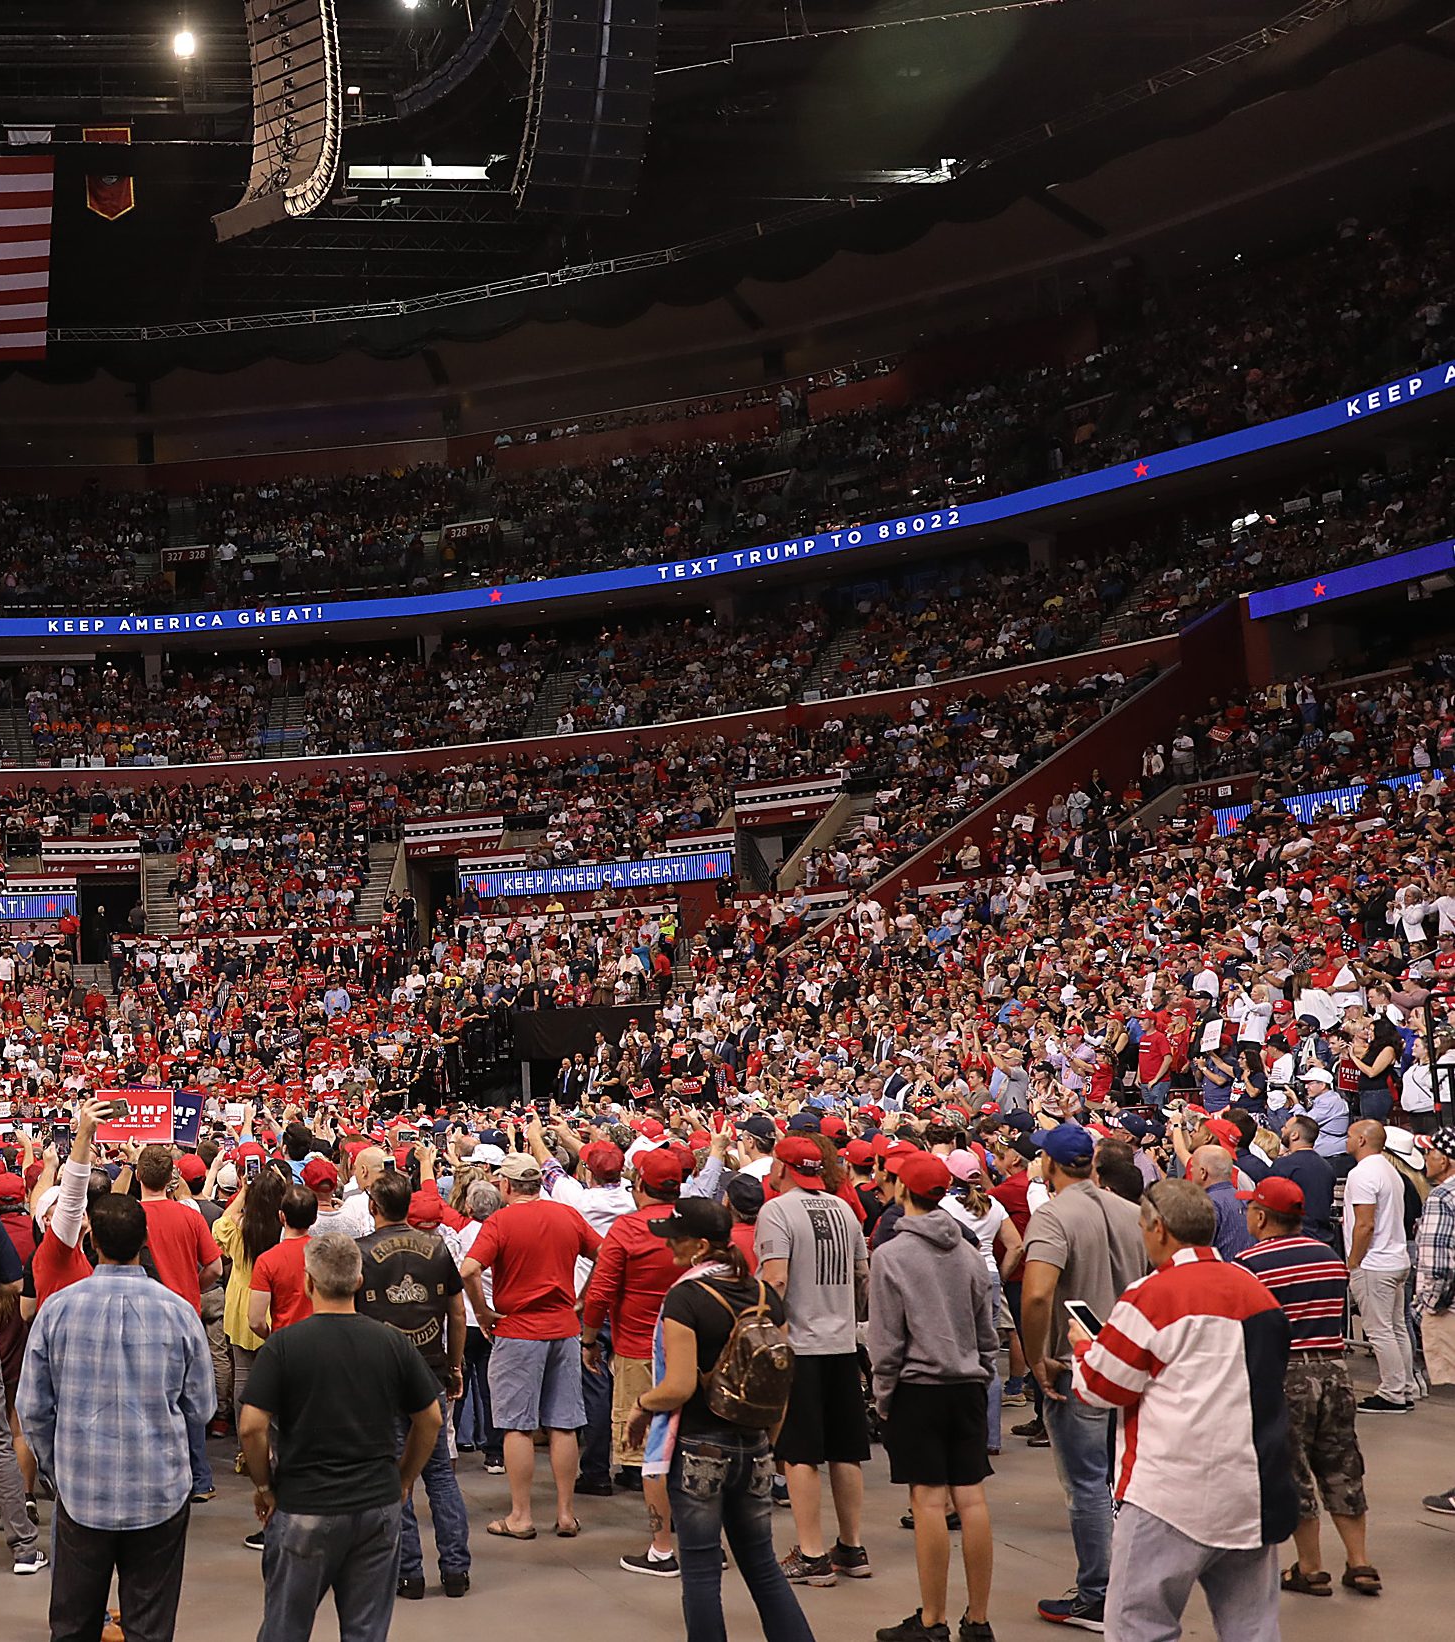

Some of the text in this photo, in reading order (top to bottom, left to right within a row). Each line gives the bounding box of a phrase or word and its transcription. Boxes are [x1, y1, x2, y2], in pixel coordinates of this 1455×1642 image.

[1346, 378, 1422, 417] KEEP
[167, 549, 206, 562] 327 328
[657, 510, 960, 580] TEXT TRUMP TO 88022
[48, 606, 322, 633] KEEP AMERICA GREAT!
[504, 863, 687, 890] KEEP AMERICA GREAT!
[800, 1199, 840, 1209] FREEDOM
[374, 1238, 433, 1258] ROLLING
